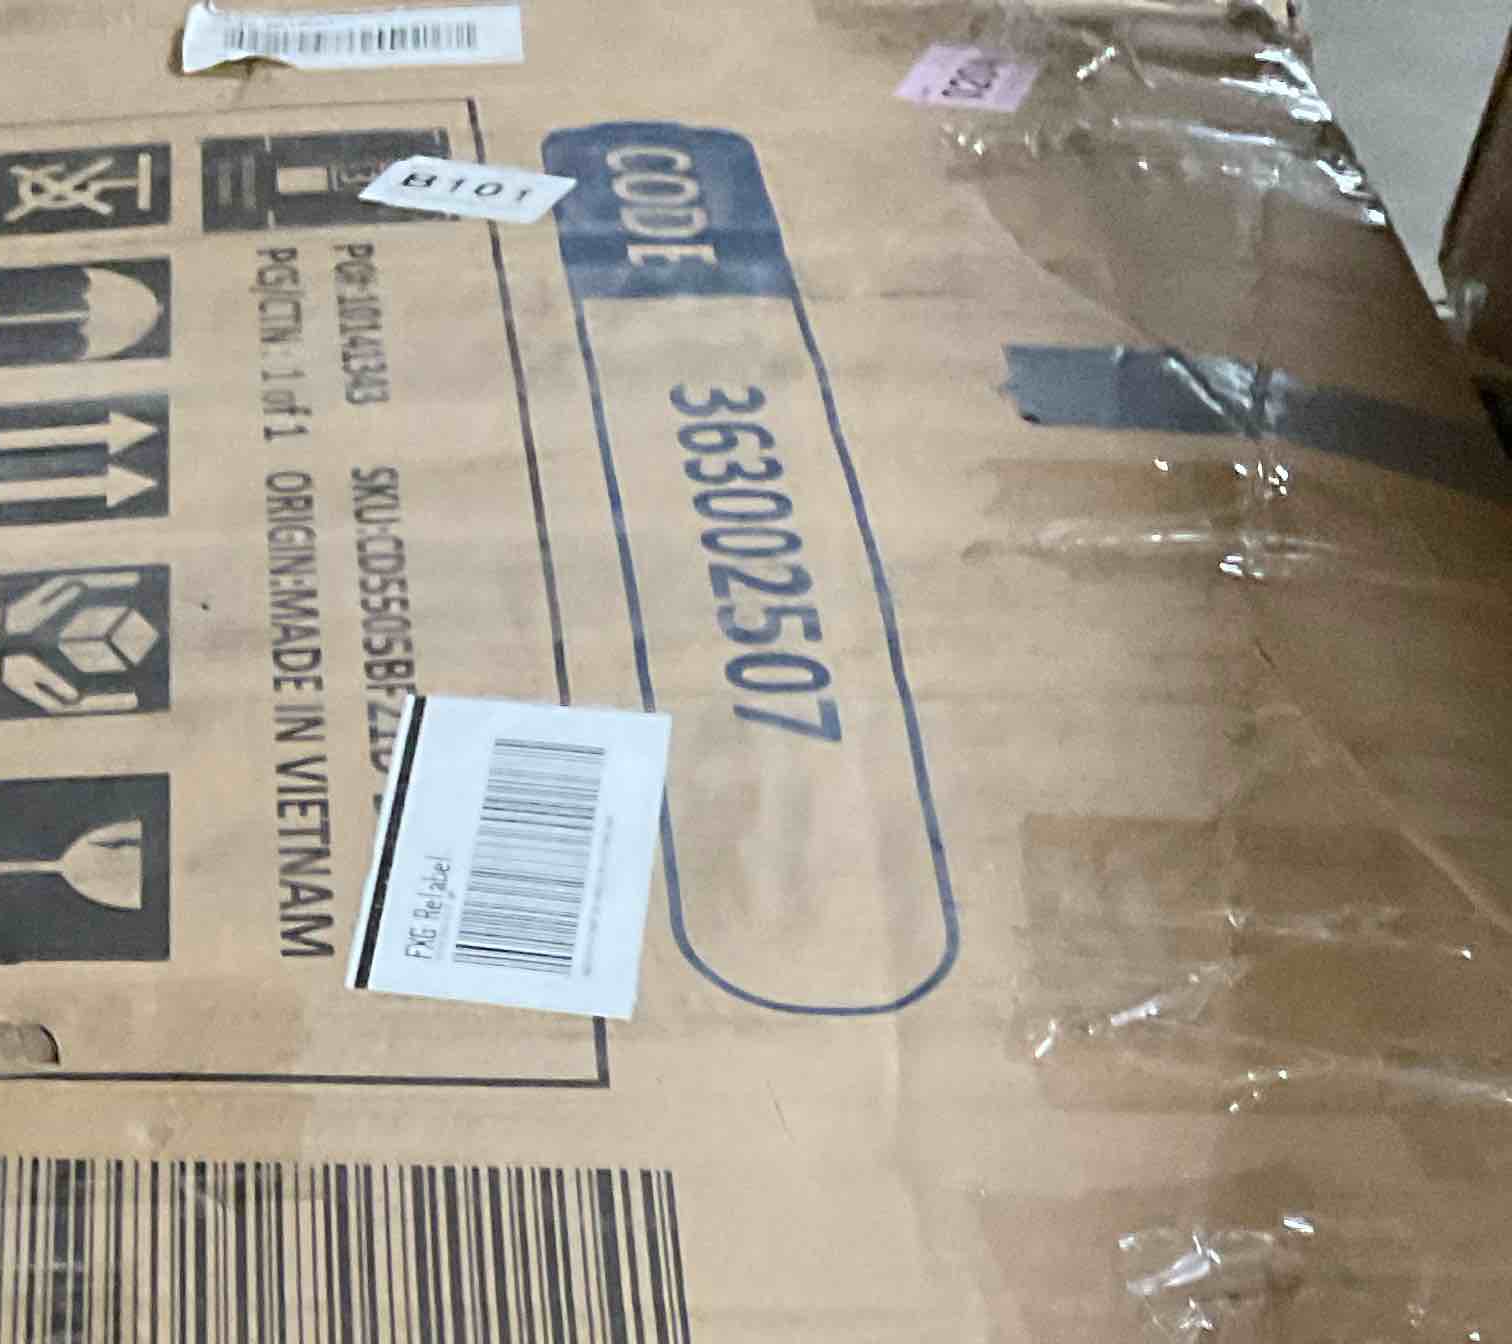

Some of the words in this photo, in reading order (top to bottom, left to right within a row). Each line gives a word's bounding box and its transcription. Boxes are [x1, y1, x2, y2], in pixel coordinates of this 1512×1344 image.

[605, 144, 719, 267] CODE
[263, 424, 310, 441] 1
[265, 470, 323, 692] ORIGIN:MADE
[670, 383, 843, 743] 363002507
[274, 705, 325, 742] IN
[275, 755, 336, 958] VIETNAM
